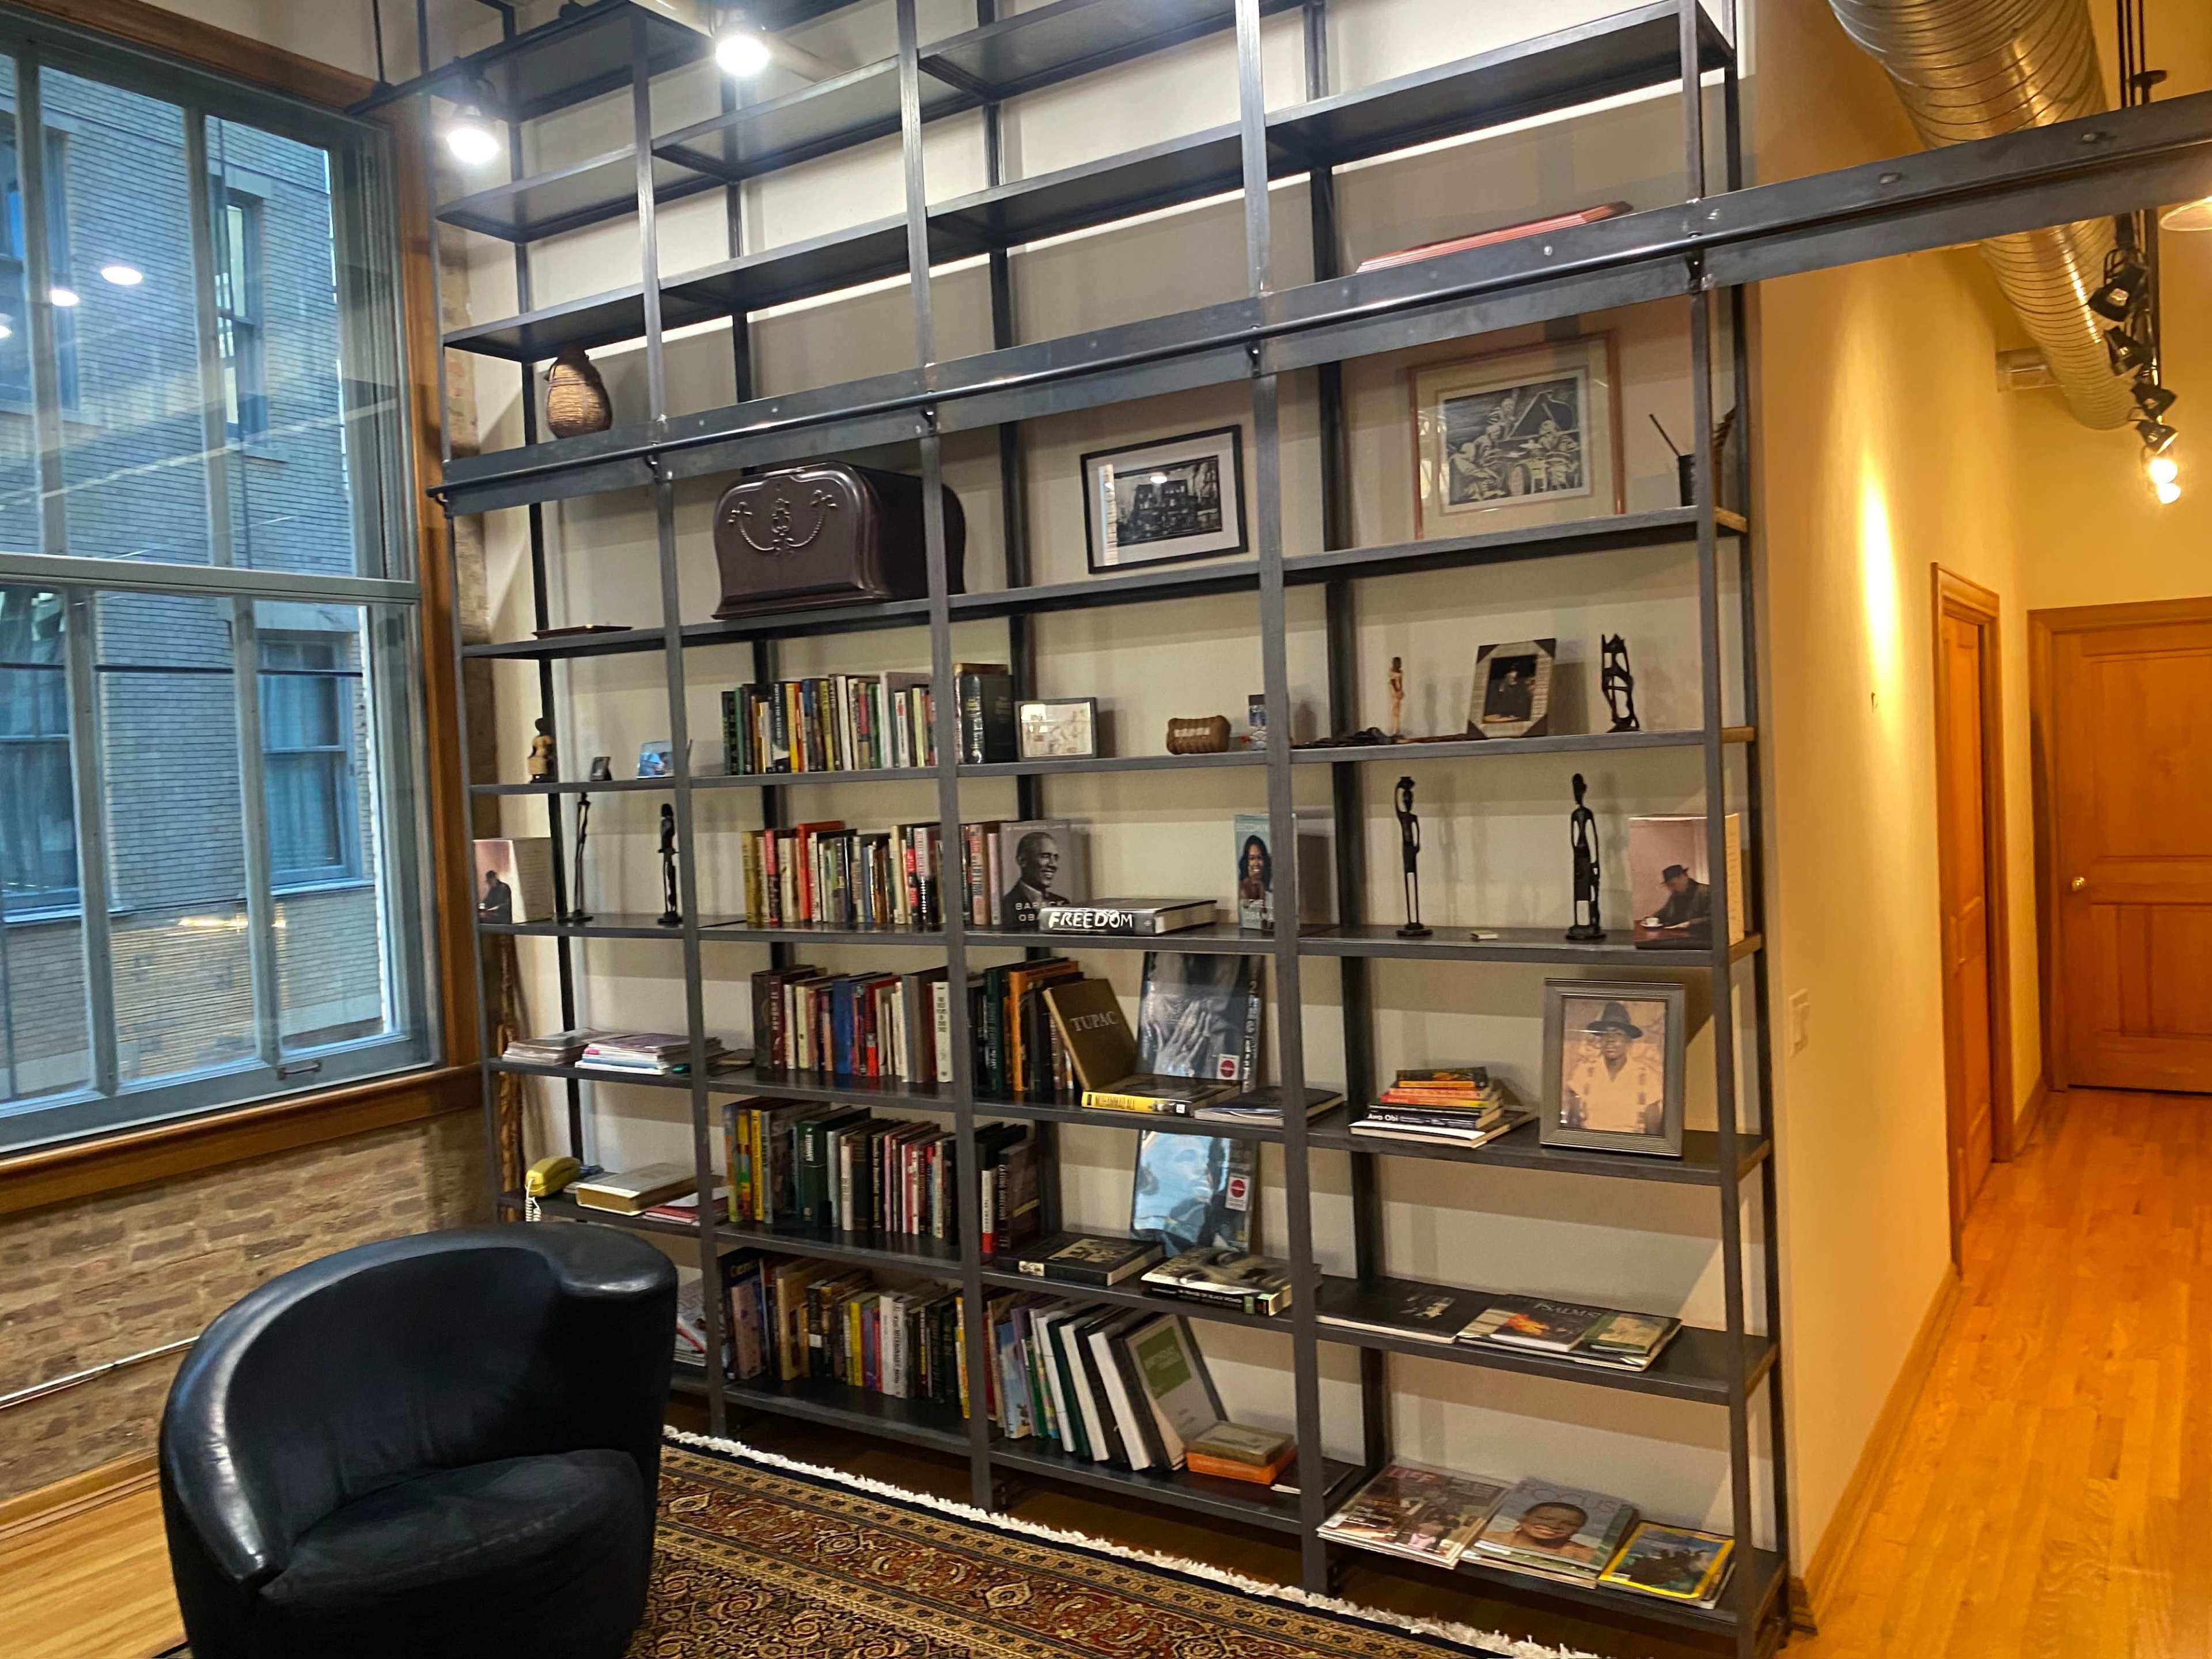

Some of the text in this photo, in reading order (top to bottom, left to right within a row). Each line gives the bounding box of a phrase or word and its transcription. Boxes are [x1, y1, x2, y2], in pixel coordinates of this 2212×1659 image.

[1048, 910, 1132, 929] FREEDOM
[1069, 1010, 1118, 1031] TUPAC
[1516, 1479, 1619, 1514] FOCUS
